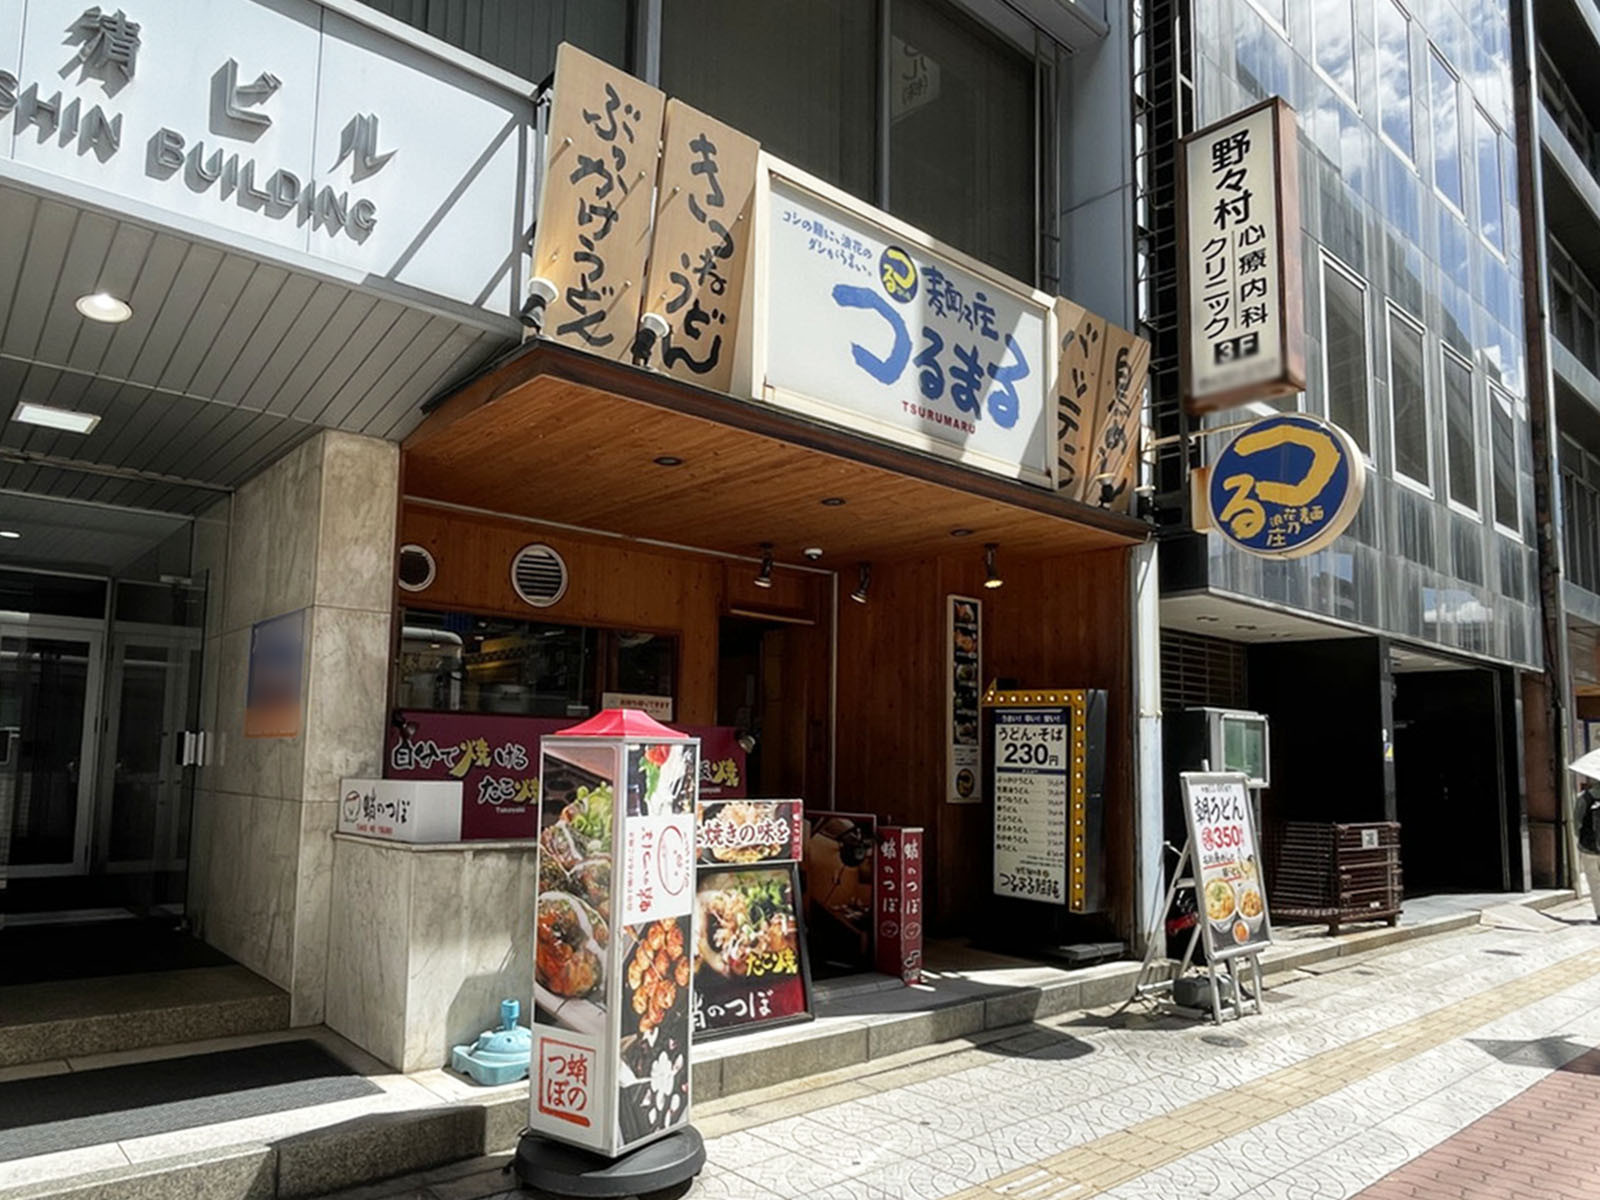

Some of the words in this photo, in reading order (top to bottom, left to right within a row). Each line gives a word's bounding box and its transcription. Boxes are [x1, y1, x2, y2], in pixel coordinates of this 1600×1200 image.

[145, 127, 377, 246] BUILDING
[557, 82, 641, 347] ぶっかけうどん
[1212, 129, 1253, 230] 野々村
[661, 133, 734, 374] きつねうどん
[1201, 237, 1231, 340] クリニック
[1238, 224, 1269, 328] 心療内科
[832, 284, 1030, 429] つるまる
[902, 401, 976, 435] TSURUMARU
[1219, 424, 1341, 540] つる
[998, 727, 1063, 742] うどん・そば
[1004, 742, 1059, 767] 230円
[746, 948, 798, 977] たこ焼
